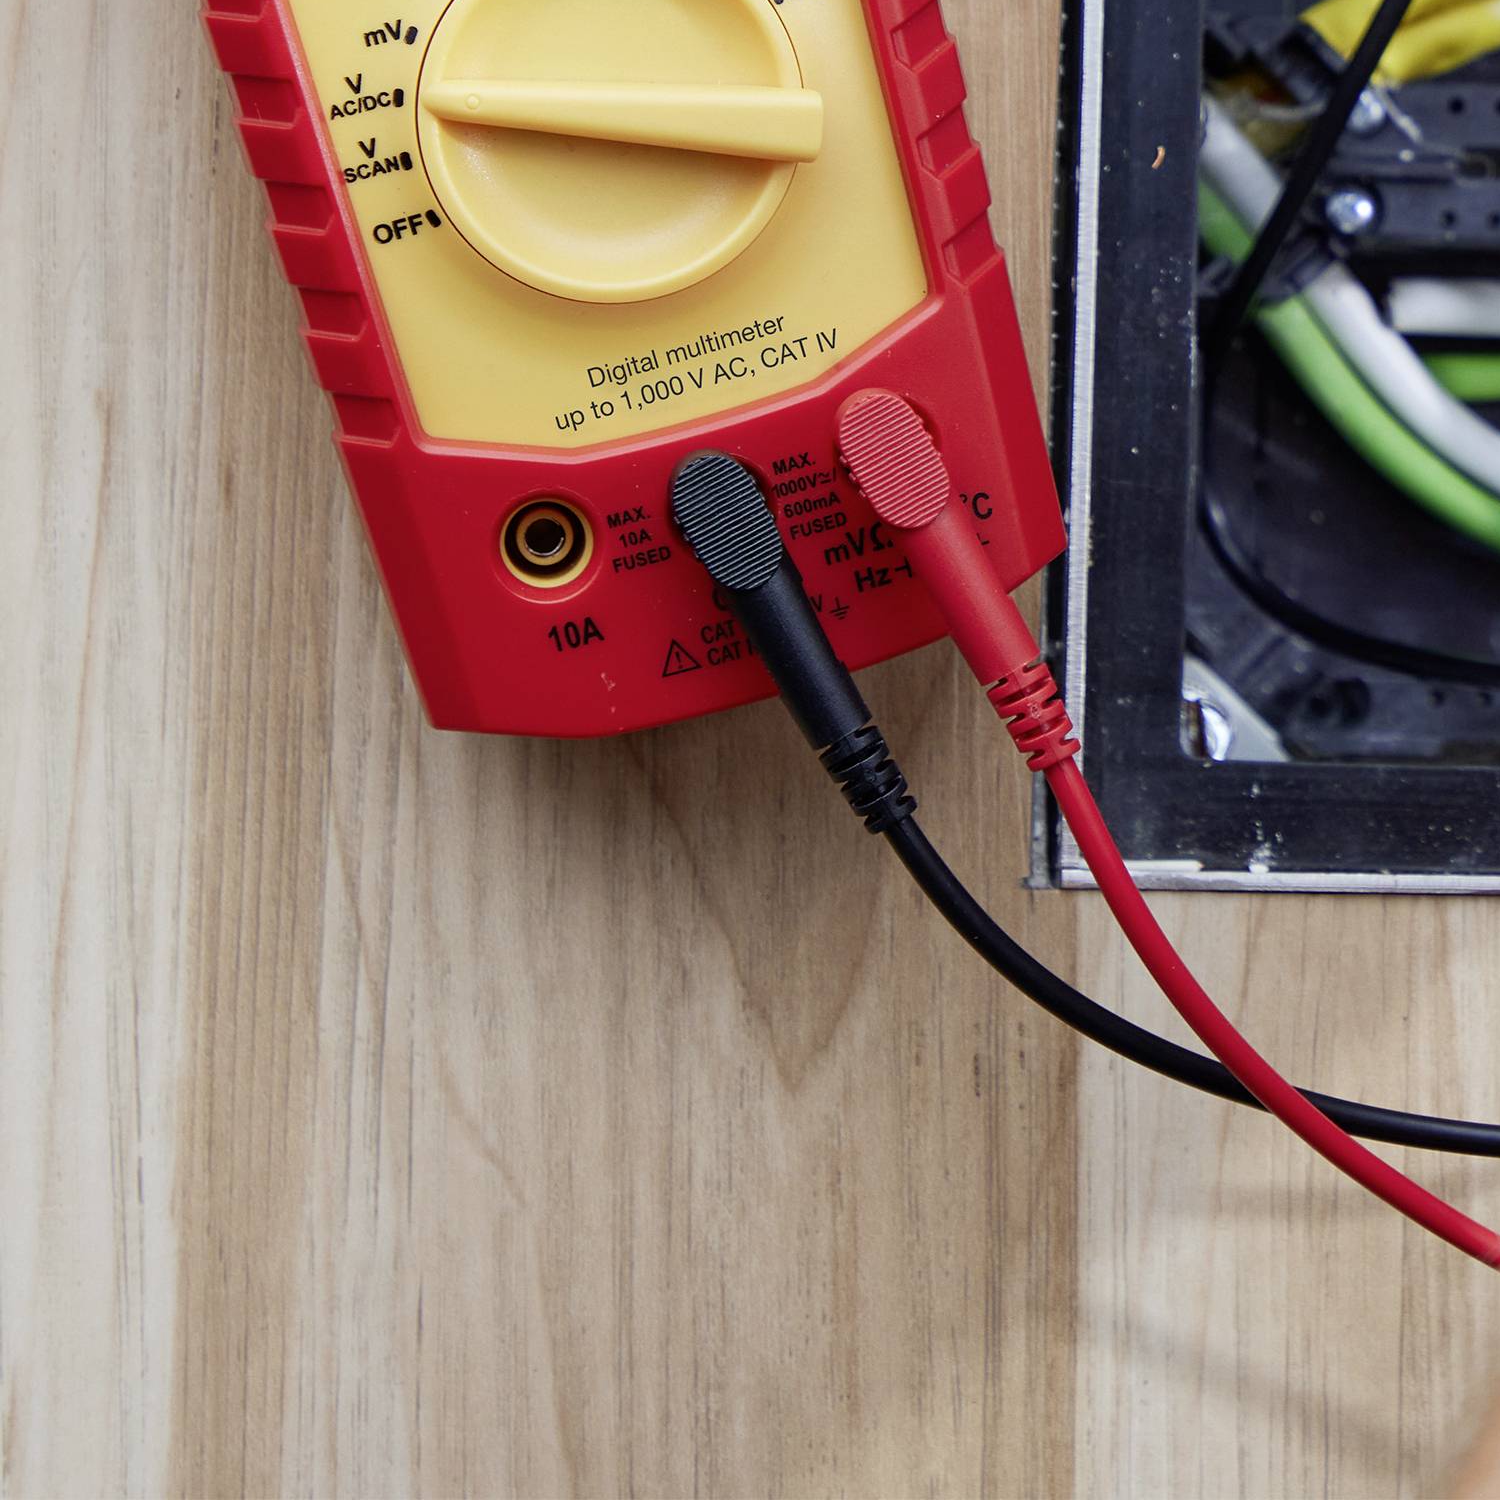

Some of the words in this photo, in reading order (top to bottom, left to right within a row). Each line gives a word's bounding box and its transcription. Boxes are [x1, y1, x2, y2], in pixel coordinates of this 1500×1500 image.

[364, 20, 402, 48] mV
[345, 73, 363, 94] V
[330, 90, 392, 120] AC/DC
[359, 139, 376, 158] V
[344, 156, 400, 183] SCAN
[373, 213, 425, 245] OFF
[587, 349, 659, 389] Digital
[666, 315, 784, 366] multimeter
[555, 409, 584, 431] up
[591, 400, 614, 419] to
[620, 376, 684, 411] 1,000
[687, 367, 704, 389] V
[714, 356, 755, 384] AC,
[761, 336, 808, 369] CAT
[816, 328, 837, 352] IV
[772, 452, 816, 475] MAX.
[607, 505, 651, 529] MAX.
[784, 491, 841, 518] 600mA
[619, 529, 653, 548] 10A
[790, 512, 847, 540] FUSED
[612, 545, 671, 574] FUSED
[855, 567, 892, 592] Hz
[548, 616, 605, 653] 10A
[701, 619, 735, 644] CAT
[707, 641, 741, 666] CAT
